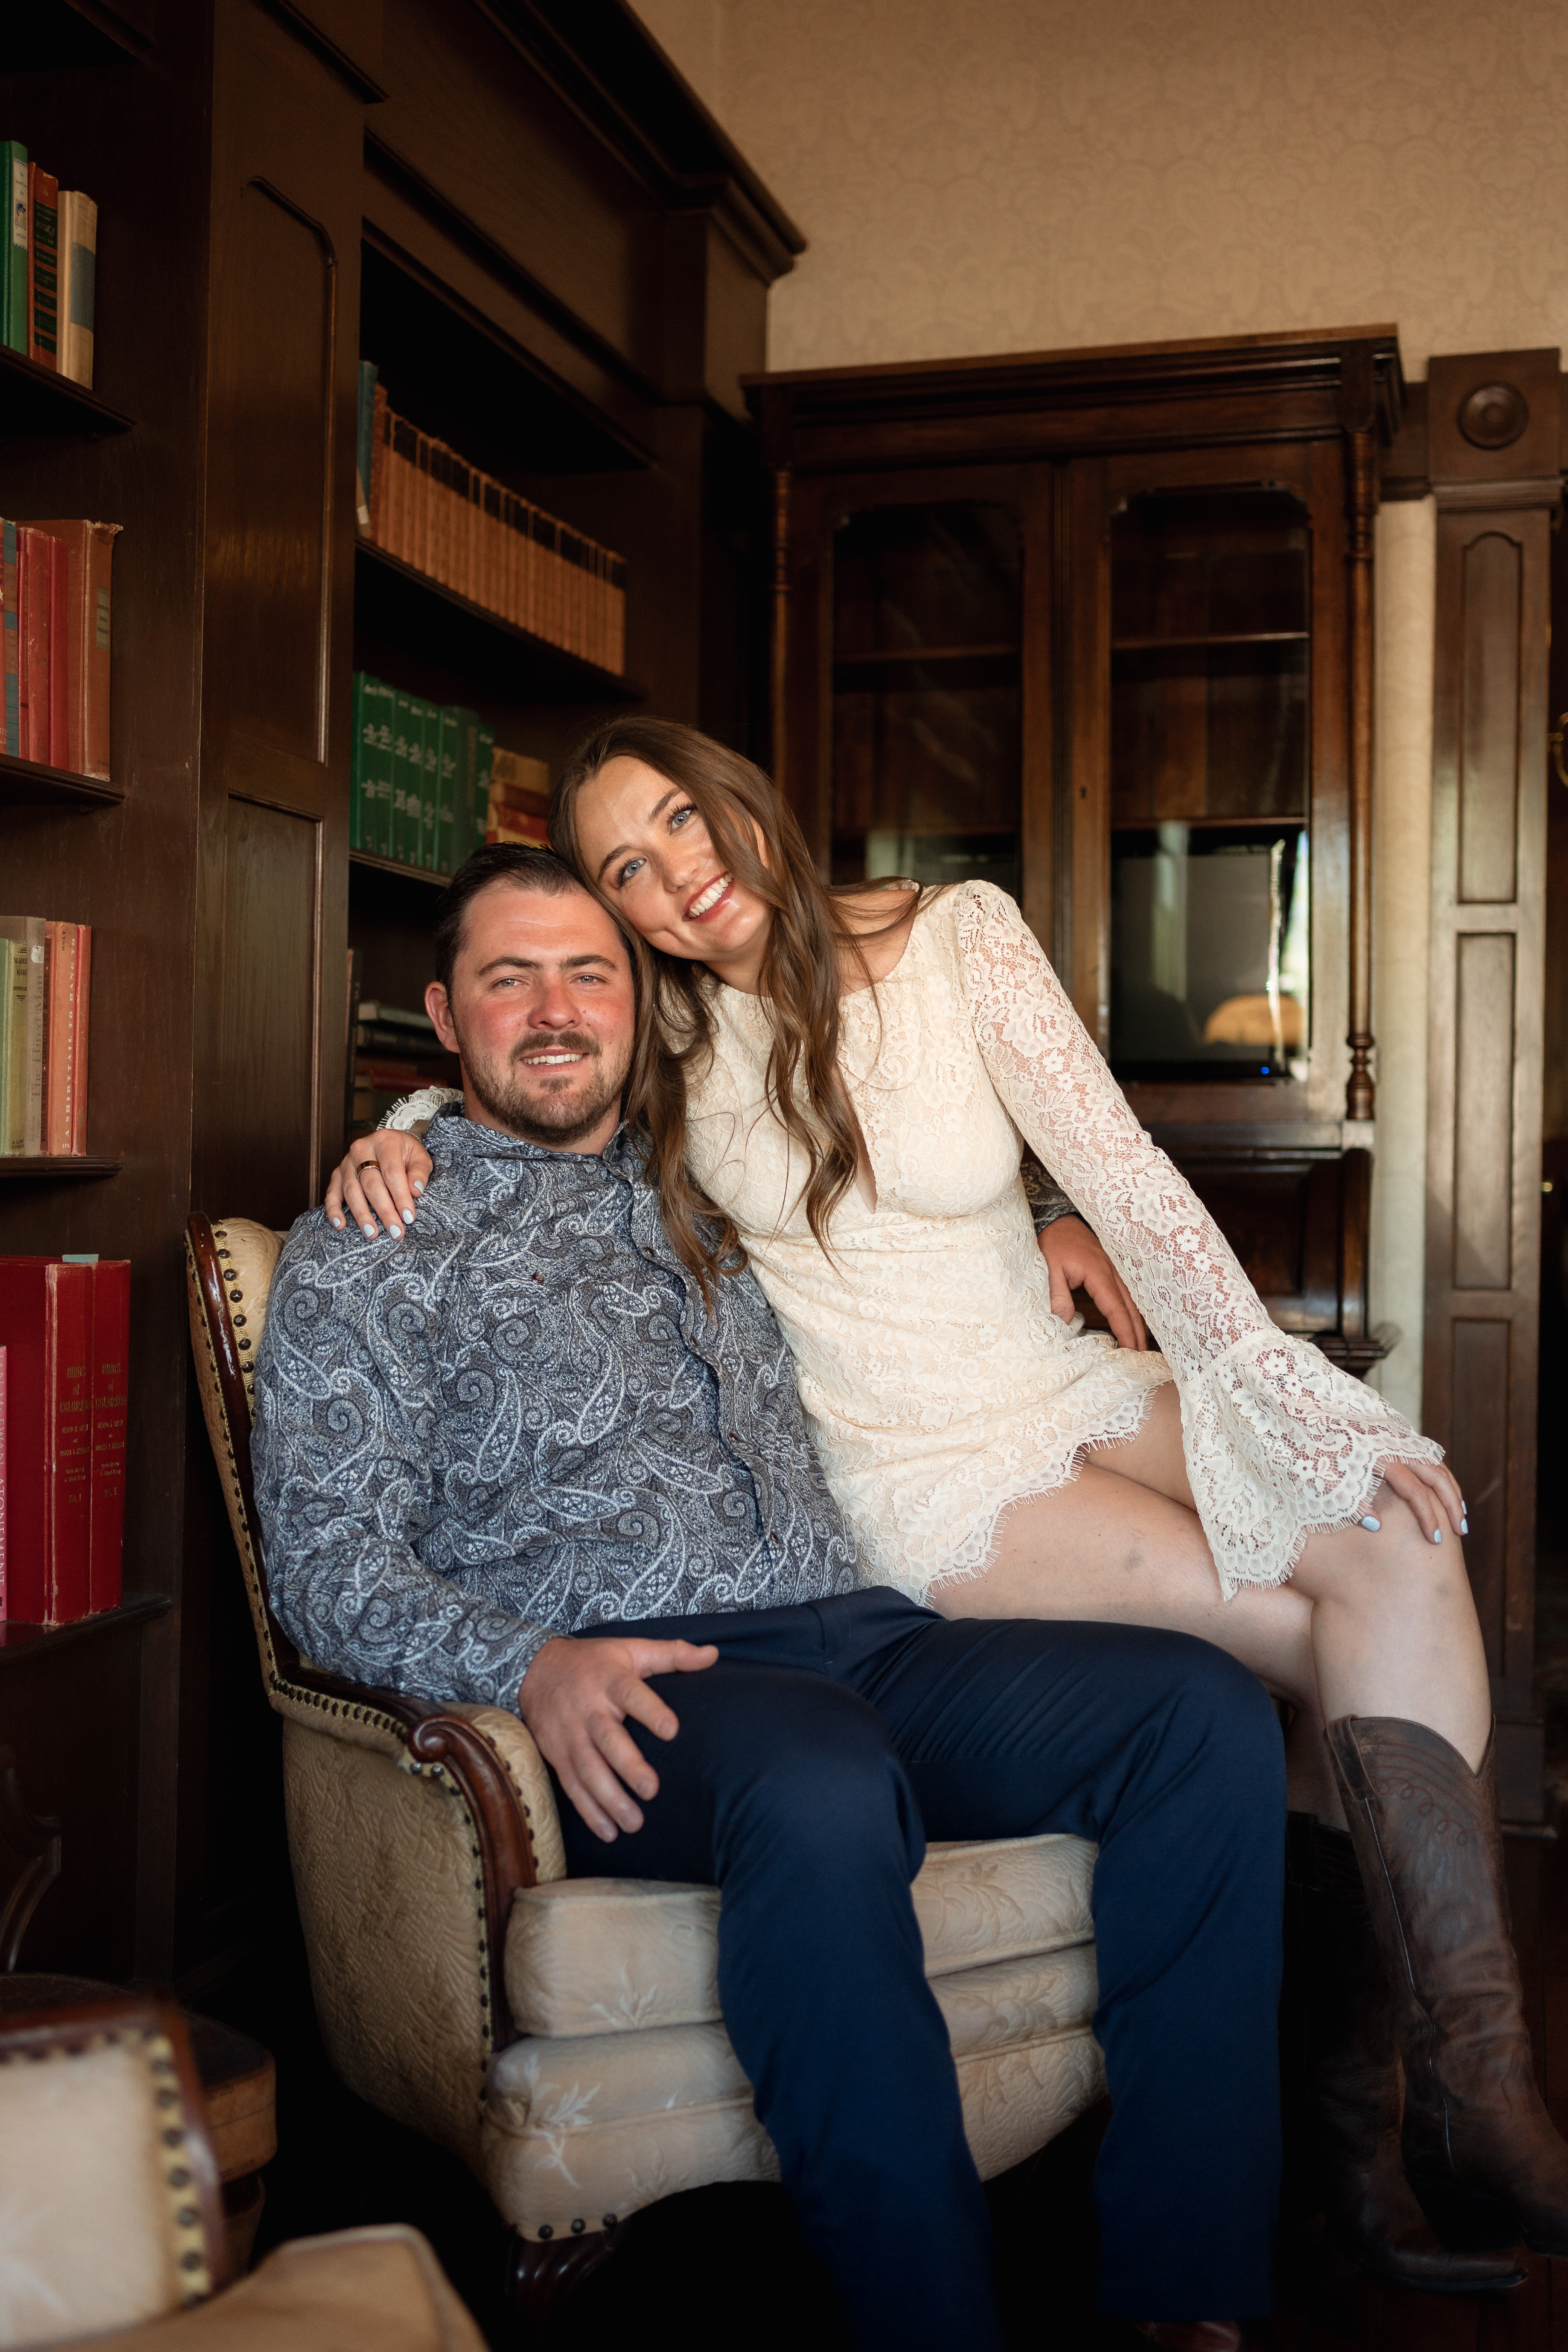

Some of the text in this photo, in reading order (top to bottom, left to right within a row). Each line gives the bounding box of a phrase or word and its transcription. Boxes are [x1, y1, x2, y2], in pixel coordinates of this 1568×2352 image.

[69, 1011, 73, 1029] TO
[71, 938, 75, 956] TO
[67, 1365, 86, 1379] BIRDS
[102, 1362, 120, 1375] BIRDS
[73, 1383, 80, 1395] of
[108, 1380, 114, 1391] of
[60, 1399, 91, 1414] COLORADO
[95, 1395, 126, 1409] COLORADO
